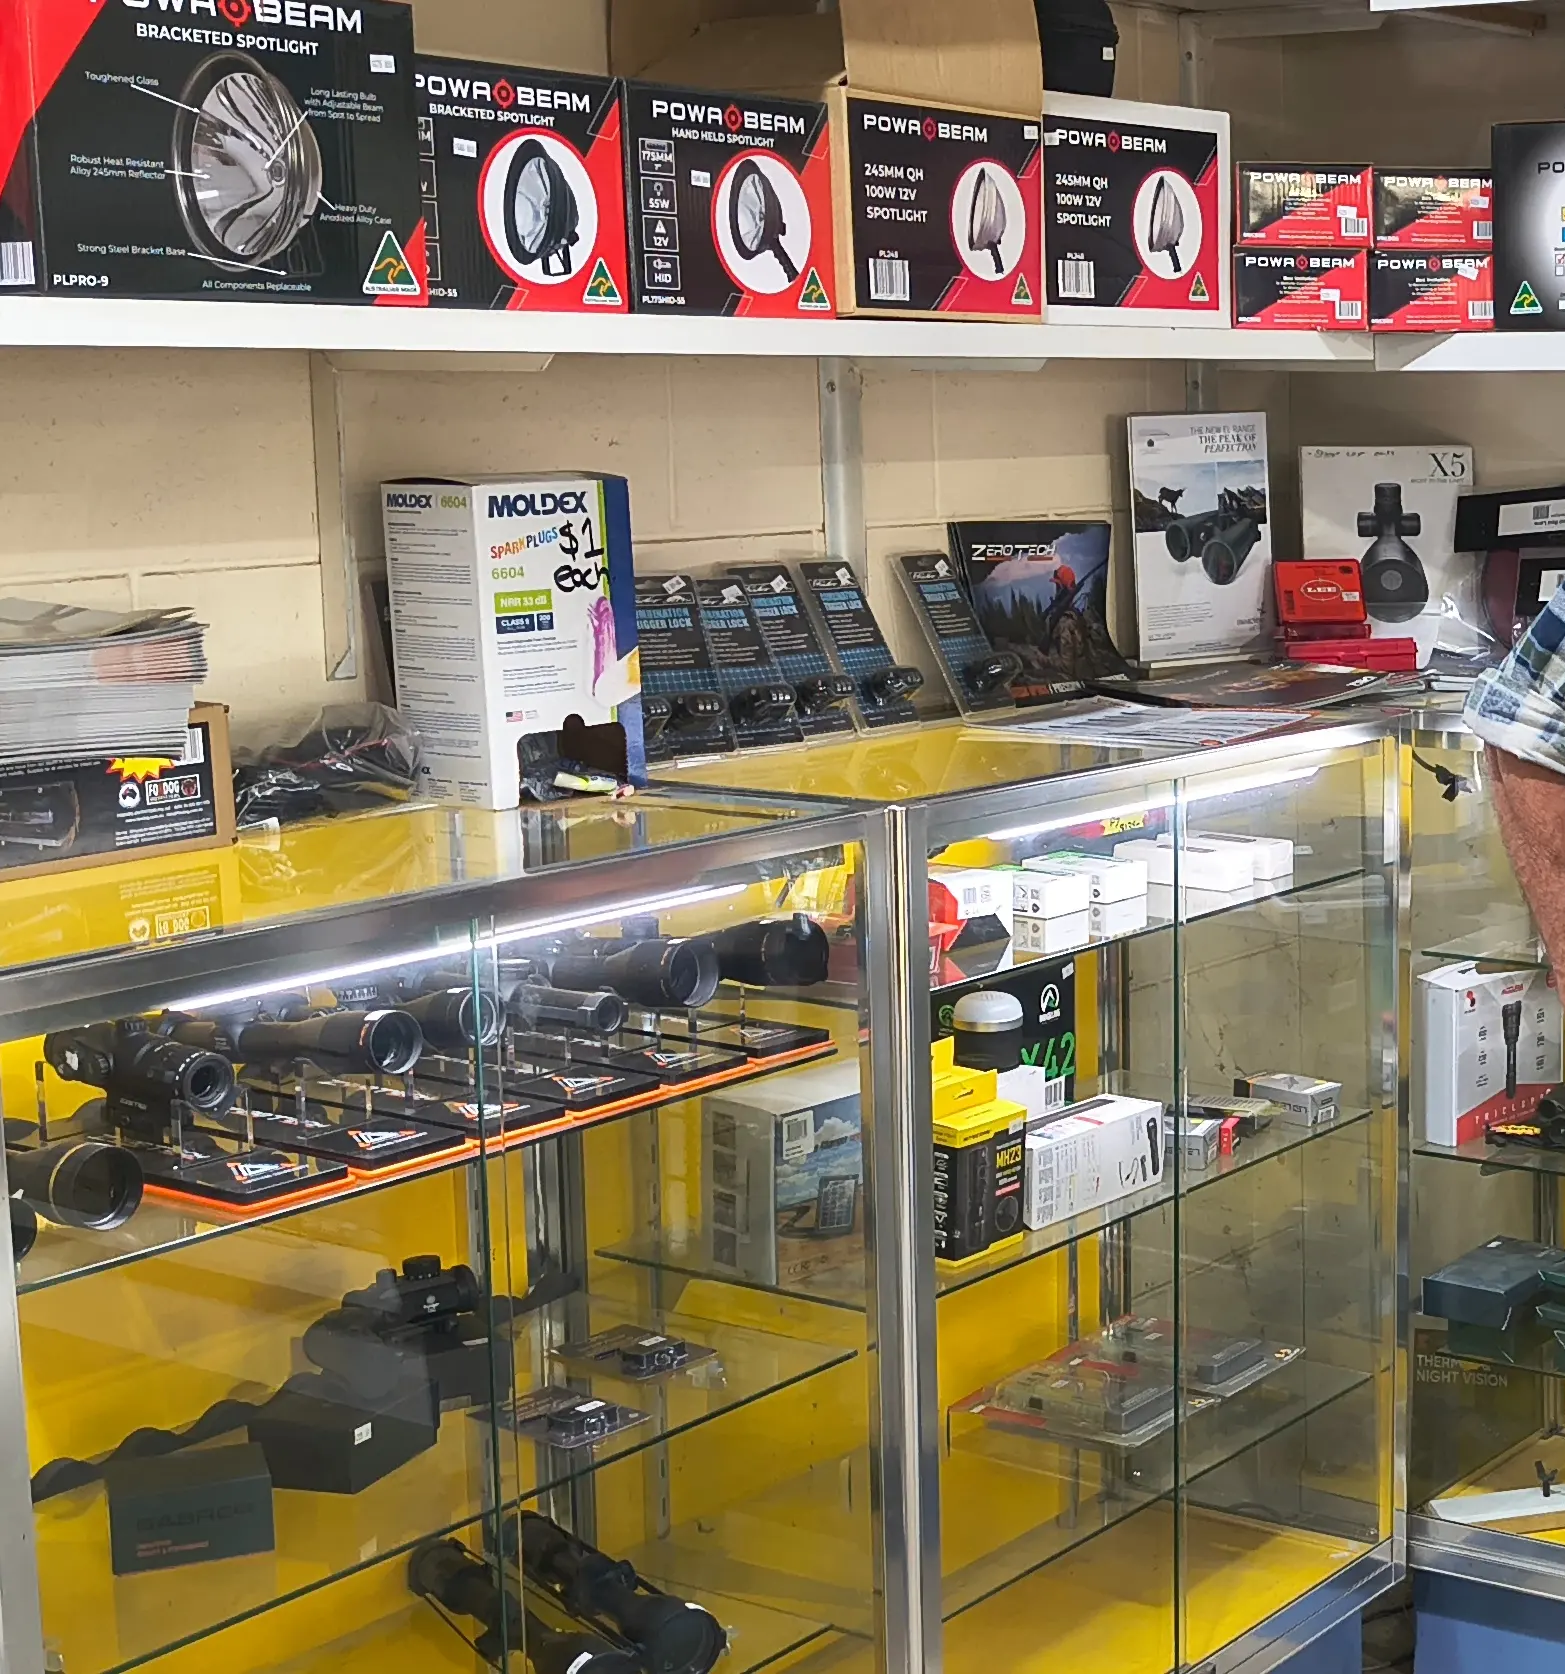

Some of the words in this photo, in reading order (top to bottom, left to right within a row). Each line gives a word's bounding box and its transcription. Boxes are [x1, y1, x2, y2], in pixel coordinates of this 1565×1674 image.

[255, 0, 362, 33] BEAM
[136, 23, 233, 46] BRACKETED
[236, 34, 319, 56] SPOTLIGHT
[85, 71, 134, 85] Toughened
[136, 75, 159, 87] Glass
[310, 87, 330, 98] Long
[517, 87, 590, 113] BEAM
[429, 103, 495, 122] BRACKETED
[497, 110, 555, 128] SPOTLIGHT
[652, 99, 723, 125] POWA
[744, 113, 805, 135] BEAM
[863, 114, 921, 136] POWA
[938, 124, 988, 143] BEAM
[671, 127, 699, 140] HAND
[700, 131, 725, 143] HELD
[726, 133, 774, 148] SPOTLIGHT
[1056, 128, 1106, 148] POWA
[1122, 135, 1167, 154] BEAM
[70, 154, 100, 166] Robust
[126, 157, 164, 169] Resistant
[641, 150, 673, 164] 175MM
[70, 166, 91, 178] Alloy
[128, 169, 165, 180] Reflector
[864, 163, 904, 180] 245MM
[907, 167, 924, 182] QH
[1250, 171, 1301, 183] POWA
[1316, 173, 1361, 184] BEAM
[1055, 173, 1091, 188] 245MM
[1093, 176, 1109, 190] QH
[1384, 176, 1433, 188] POWA
[1448, 178, 1493, 189] BEAM
[865, 184, 896, 200] 100W
[898, 187, 917, 201] 12V
[1056, 192, 1083, 207] 100W
[1085, 194, 1102, 208] 12V
[648, 198, 670, 210] 55W
[866, 206, 928, 223] SPOTLIGHT
[1056, 212, 1112, 228] SPOTLIGHT
[652, 235, 670, 247] 12V
[77, 243, 106, 256] Strong
[108, 243, 129, 255] Steel
[132, 245, 163, 256] Bracket
[165, 246, 186, 256] Base
[1245, 256, 1295, 268] POWA
[1309, 257, 1355, 268] BEAM
[1377, 258, 1427, 270] POWA
[1442, 258, 1488, 269] BEAM
[53, 273, 109, 288] PLPRO-9
[654, 271, 672, 284] HID
[202, 280, 211, 290] All
[213, 281, 264, 292] Components
[1428, 452, 1466, 477] X5
[386, 492, 433, 508] MOLDEX
[488, 491, 588, 519] MOLDEX
[558, 517, 605, 562] $1
[491, 566, 525, 580] 6604
[553, 561, 611, 593] each
[501, 617, 524, 627] CLASS
[1416, 1369, 1461, 1384] NIGHT
[1462, 1370, 1508, 1388] VISION
